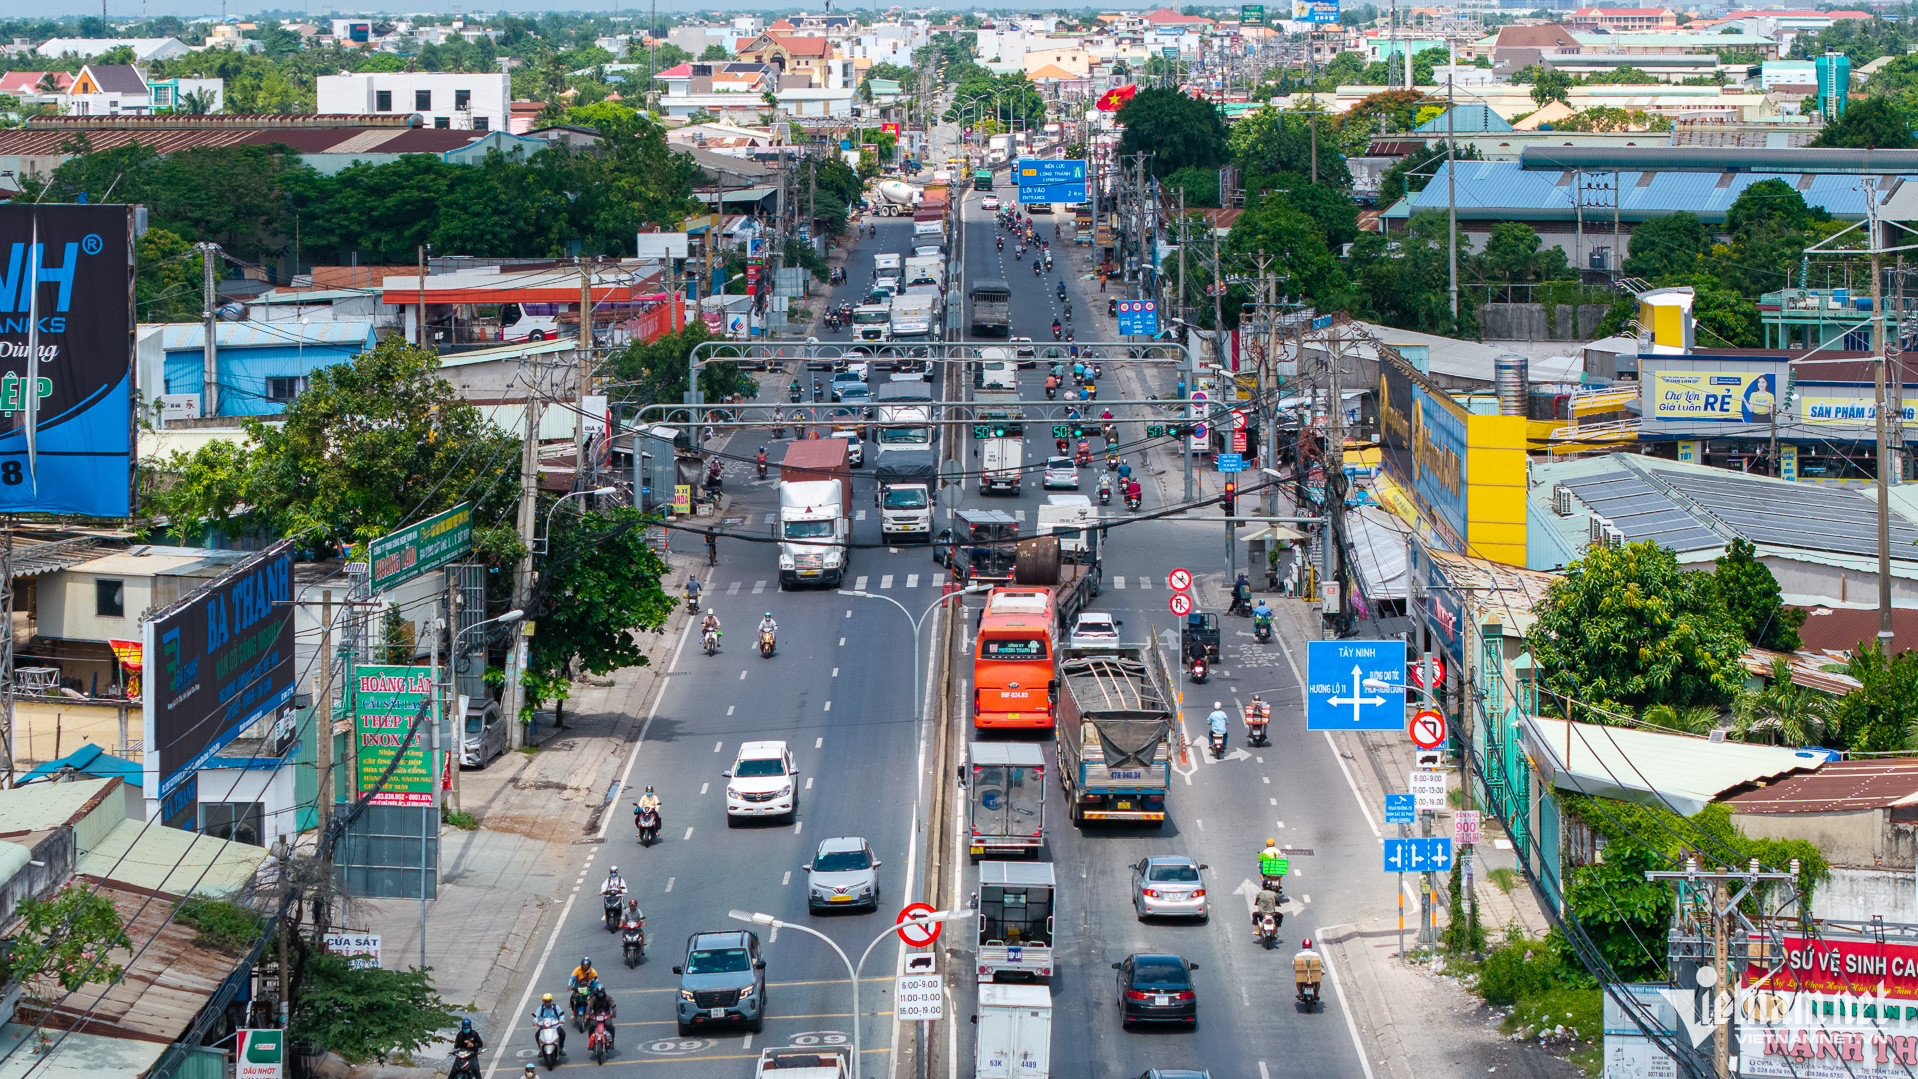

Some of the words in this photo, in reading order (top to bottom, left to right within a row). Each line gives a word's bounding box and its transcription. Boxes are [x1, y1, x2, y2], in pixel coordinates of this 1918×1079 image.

[1665, 390, 1683, 403] Chợ
[1703, 388, 1732, 412] RẺ
[1659, 403, 1676, 411] Giá
[1677, 402, 1702, 411] Luôn
[975, 427, 990, 438] 50
[1053, 426, 1067, 438] 50
[207, 592, 229, 655] BA
[232, 556, 290, 635] THANH
[1339, 646, 1354, 658] TÂY
[1356, 648, 1376, 658] NINH
[360, 672, 406, 693] HOÀNG
[1310, 684, 1331, 693] HƯƠNG
[1332, 682, 1340, 695] LỘ
[1341, 685, 1346, 693] 11
[361, 733, 401, 746] INOX
[1455, 822, 1476, 832] 900
[327, 936, 351, 946] CỬA
[1790, 945, 1815, 970] SỨ
[1818, 947, 1841, 976] VỆ
[1846, 954, 1887, 976] SINH
[1891, 957, 1918, 977] CA
[1763, 1028, 1864, 1063] MẠNH
[989, 1060, 1003, 1068] 63K
[1020, 1060, 1037, 1069] 4489
